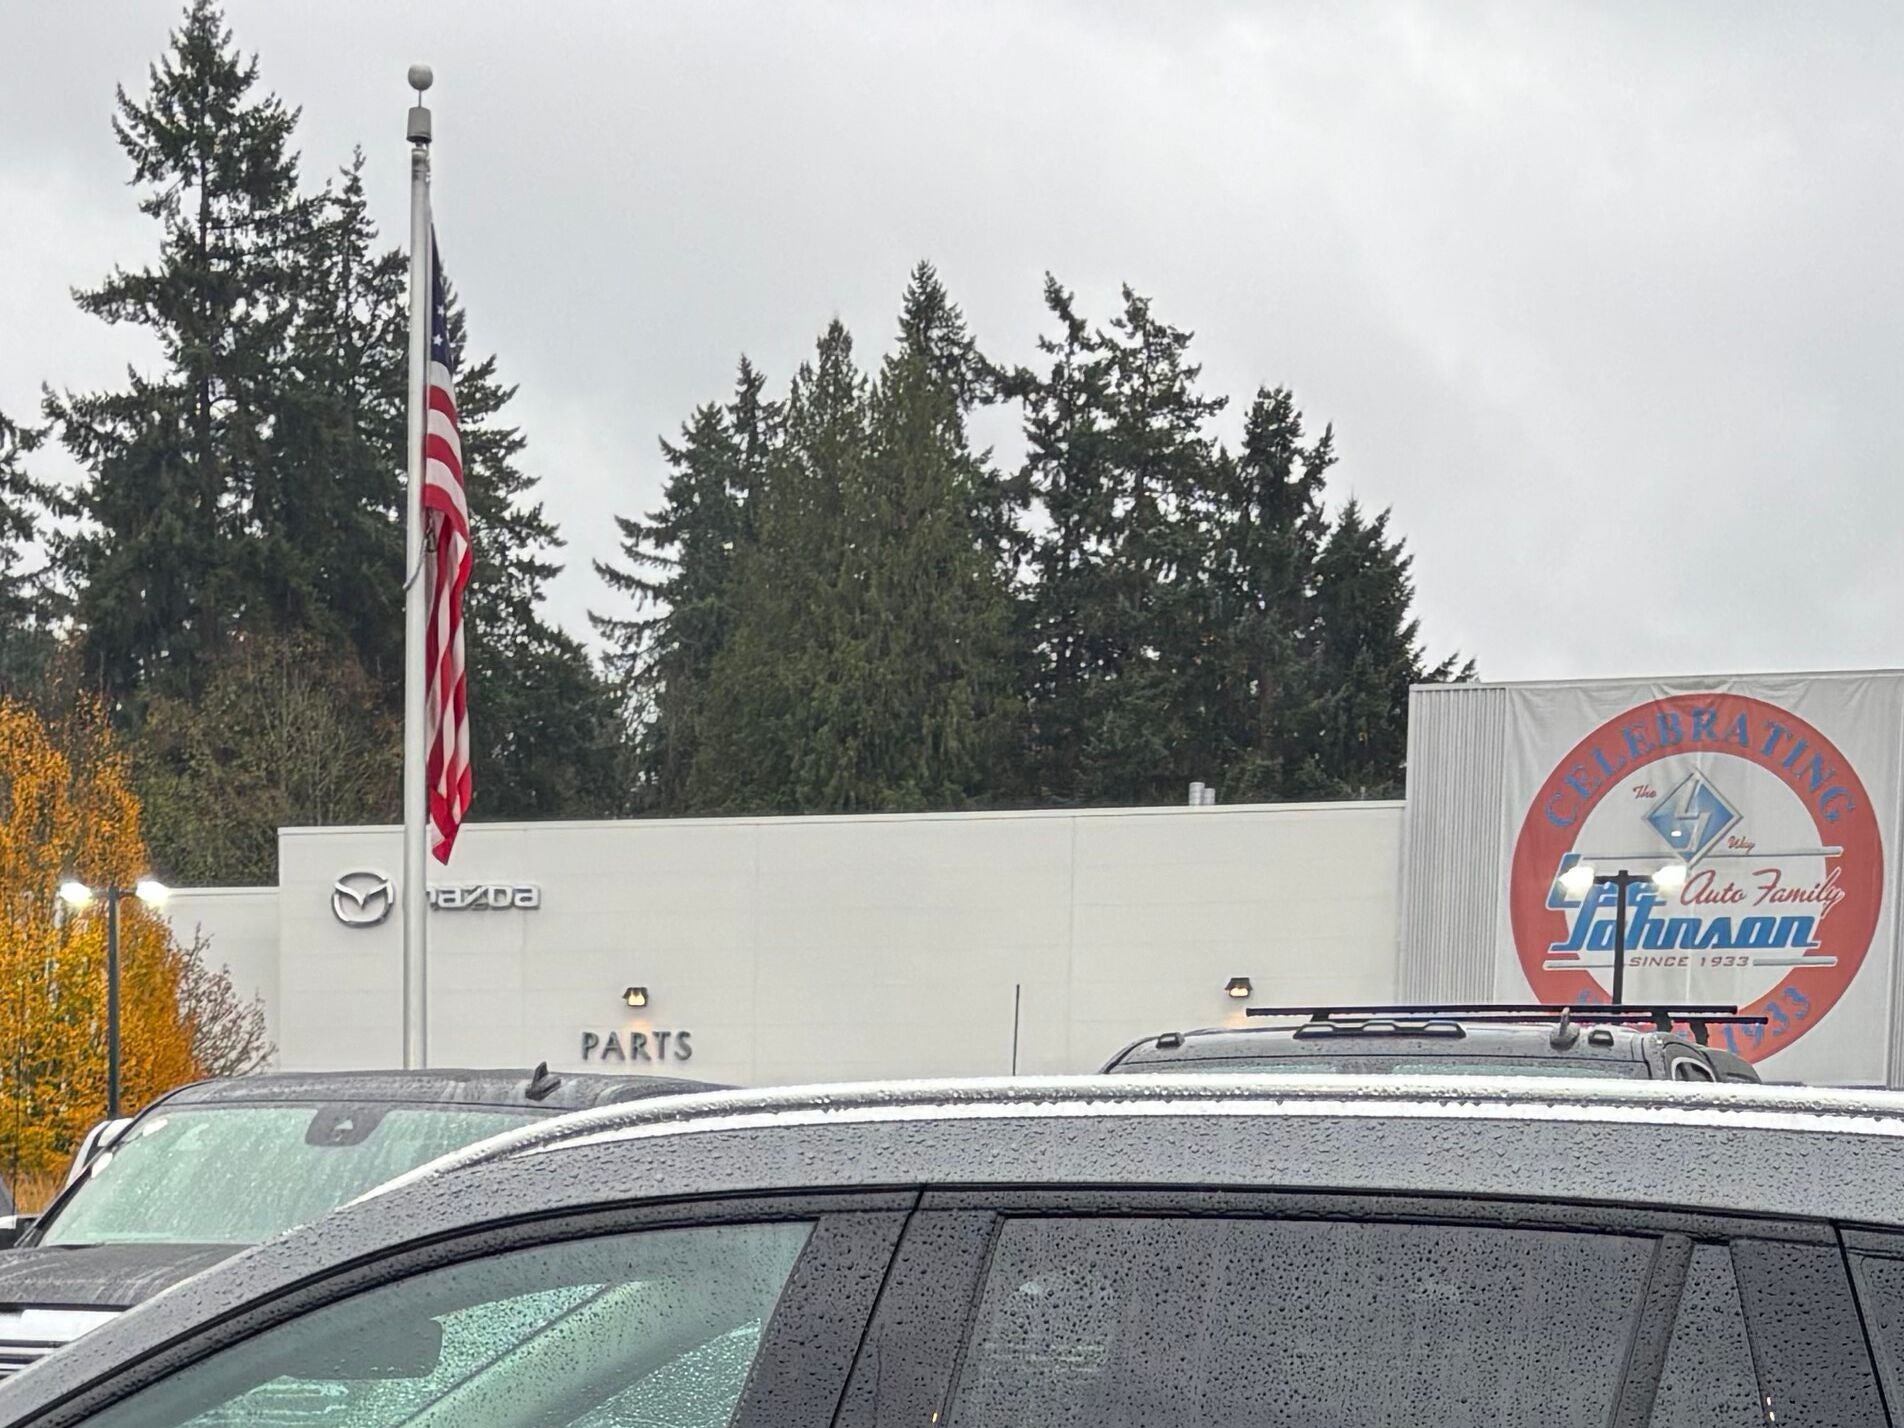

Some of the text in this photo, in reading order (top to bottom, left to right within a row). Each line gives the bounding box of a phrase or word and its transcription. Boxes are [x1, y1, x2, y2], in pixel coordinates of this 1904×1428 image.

[1544, 706, 1857, 827] CELEBRATING
[1633, 784, 1657, 799] The
[1728, 835, 1755, 855] Way
[427, 884, 541, 911] azda
[1680, 866, 1846, 918] Auto Family
[1548, 893, 1822, 952] Johnson
[1628, 955, 1750, 968] SINCE 1933
[581, 1031, 693, 1061] PARTS
